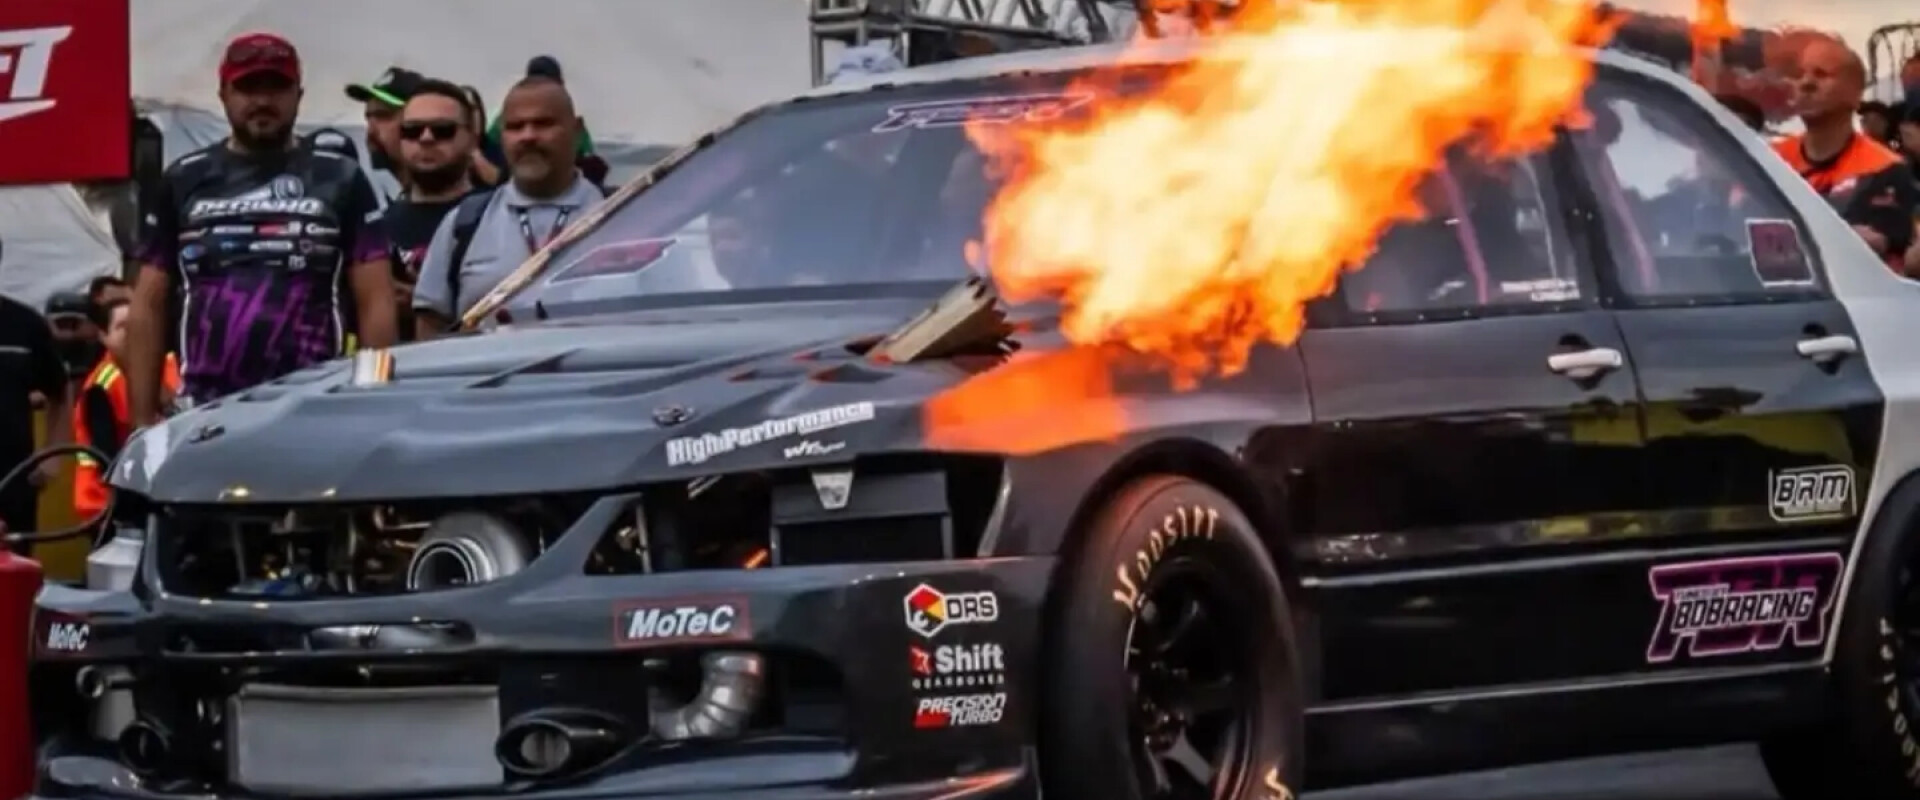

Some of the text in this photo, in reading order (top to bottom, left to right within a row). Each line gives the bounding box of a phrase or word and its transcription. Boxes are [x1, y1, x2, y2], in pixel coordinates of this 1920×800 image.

[1774, 471, 1850, 506] BRM
[628, 604, 735, 639] MoTeC
[946, 593, 997, 622] DRS
[1671, 588, 1817, 633] BOBRACING
[935, 643, 1005, 674] Shift
